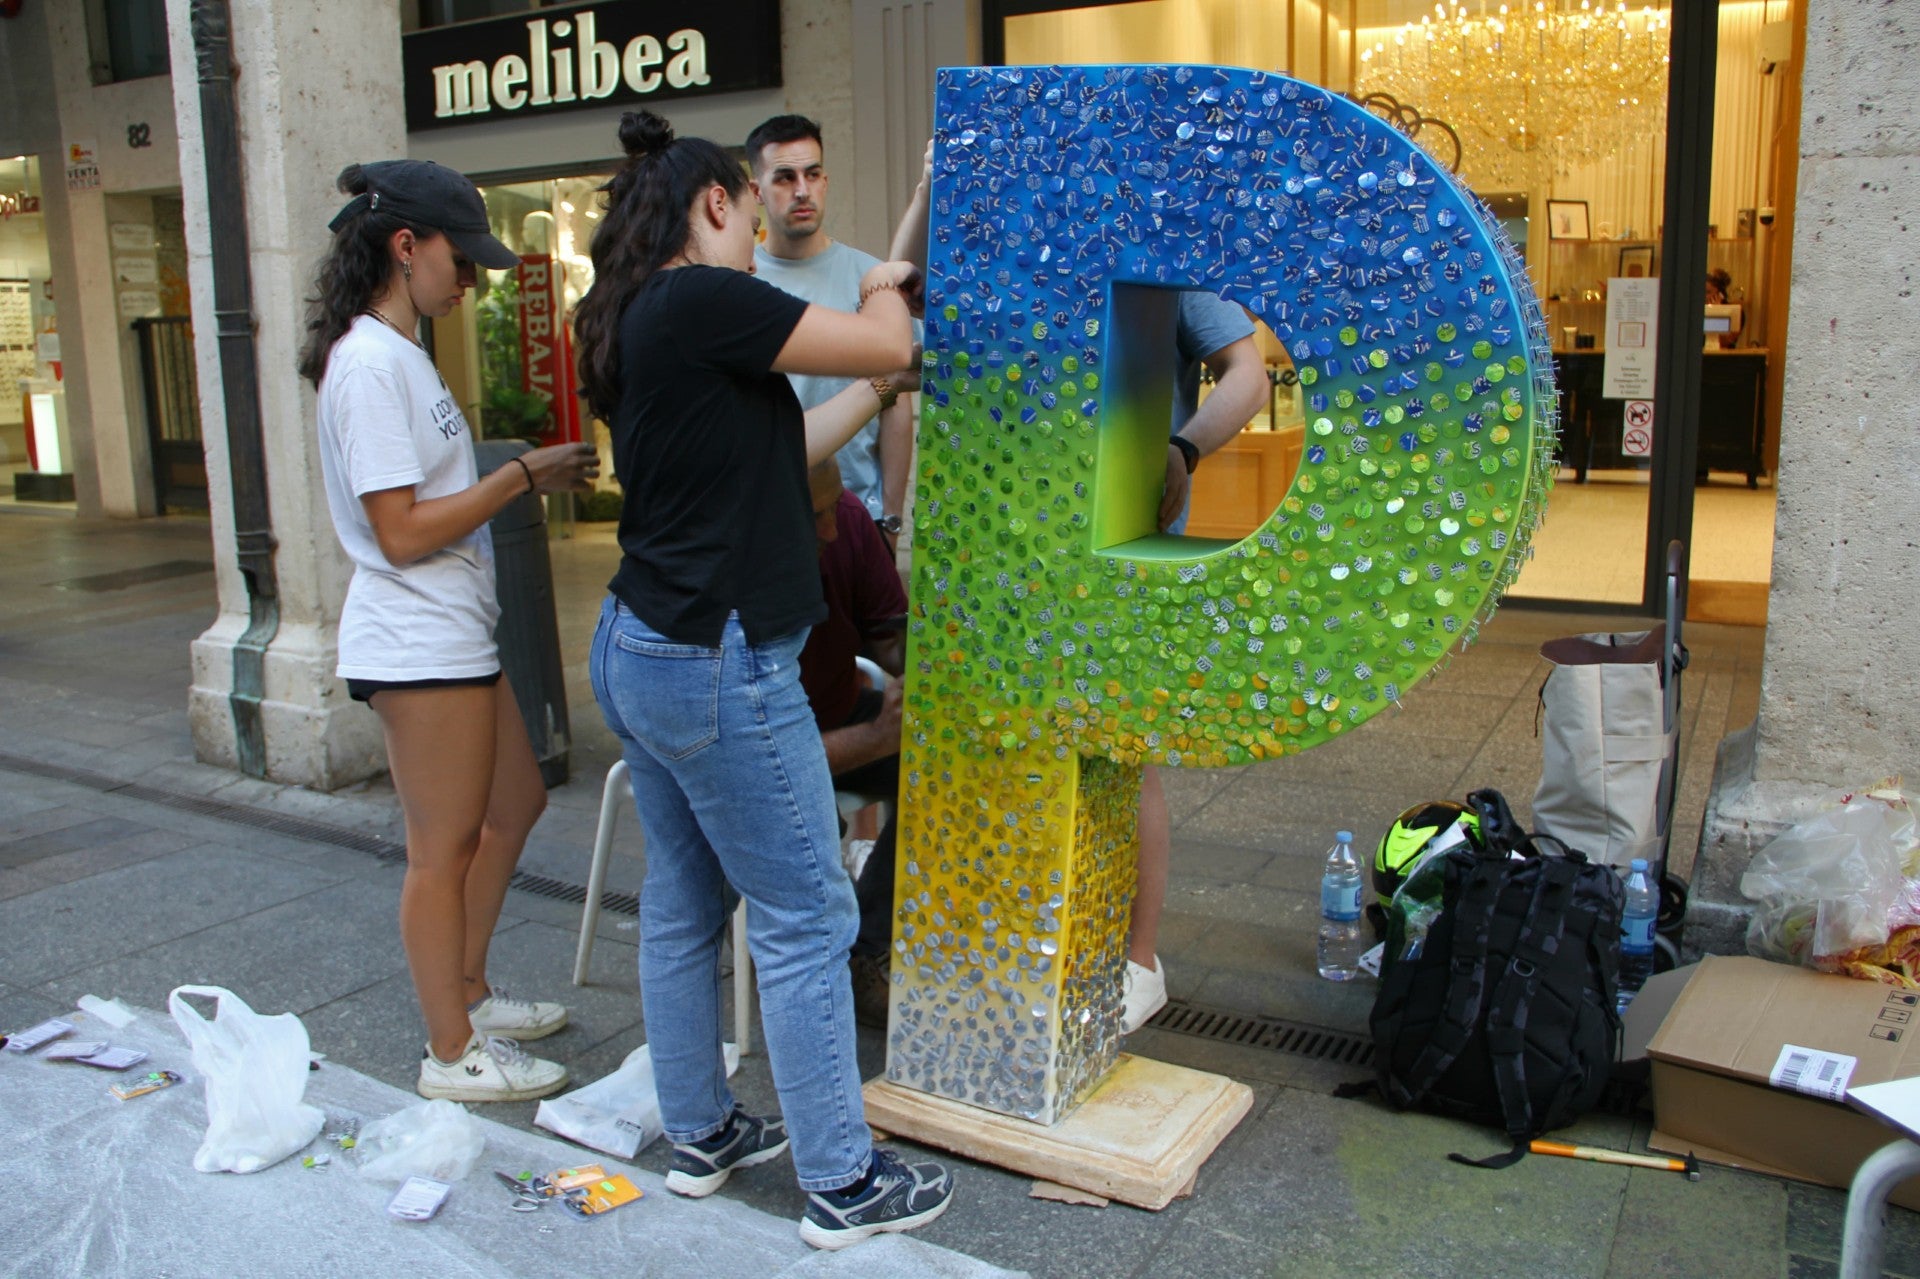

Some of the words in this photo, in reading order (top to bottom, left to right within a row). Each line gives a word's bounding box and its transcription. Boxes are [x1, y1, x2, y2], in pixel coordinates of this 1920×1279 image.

[432, 11, 711, 118] melibea
[128, 123, 152, 148] 82
[67, 166, 99, 179] VENTA
